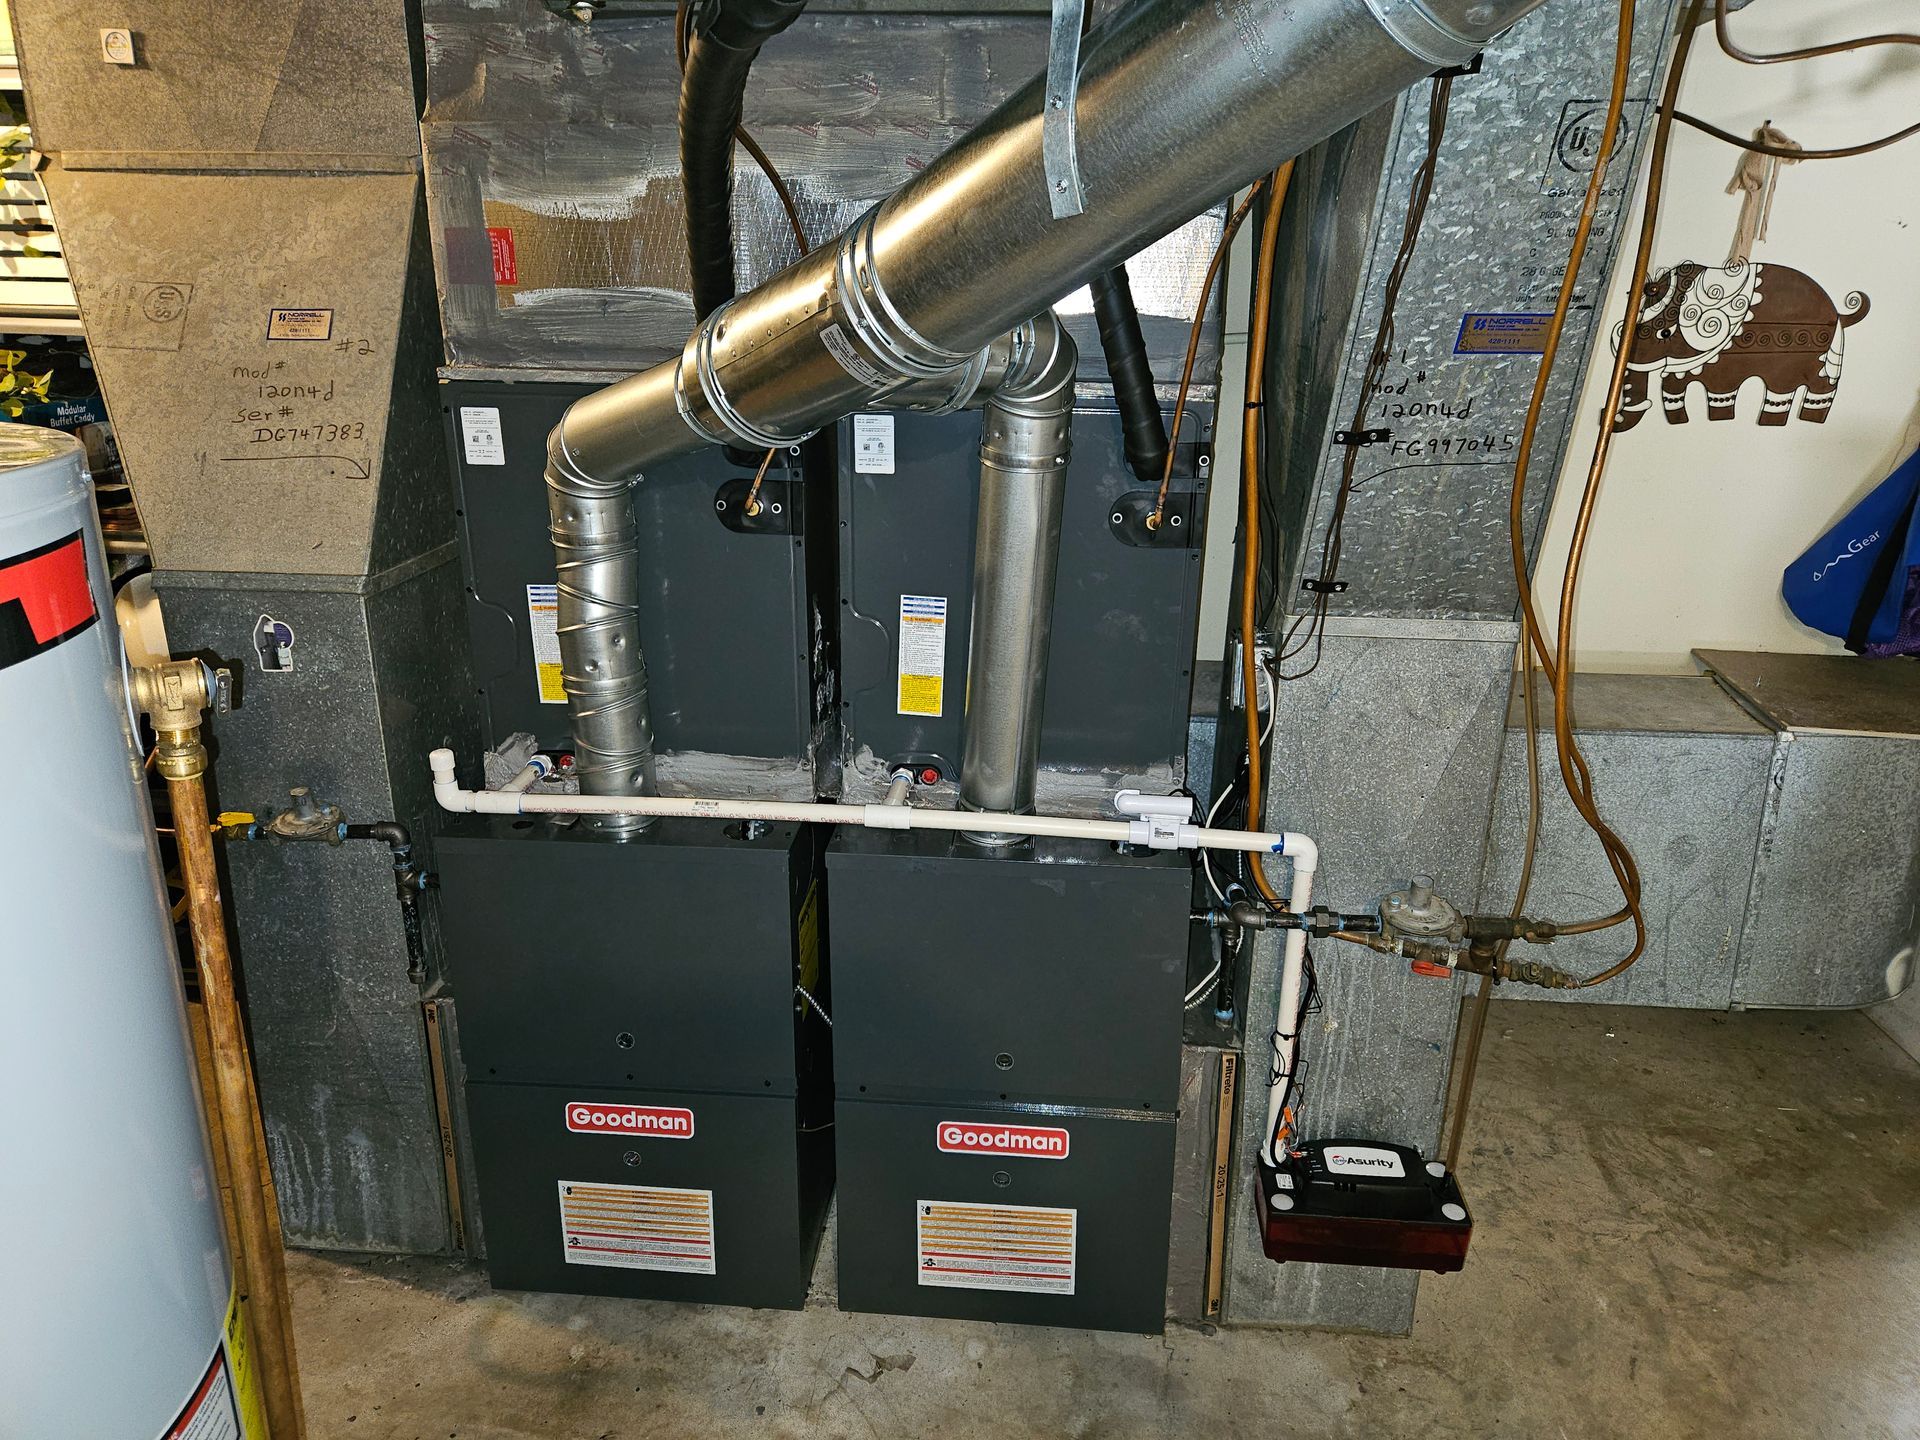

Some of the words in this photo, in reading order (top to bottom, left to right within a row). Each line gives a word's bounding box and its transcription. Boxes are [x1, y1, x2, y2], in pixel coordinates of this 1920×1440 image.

[57, 405, 87, 416] Modular
[50, 416, 73, 427] Buffet
[74, 413, 95, 424] Caddy
[1223, 1058, 1234, 1095] Filtrete
[572, 1108, 687, 1131] Goodman
[943, 1127, 1062, 1151] Goodman
[1347, 1157, 1394, 1169] Asurity
